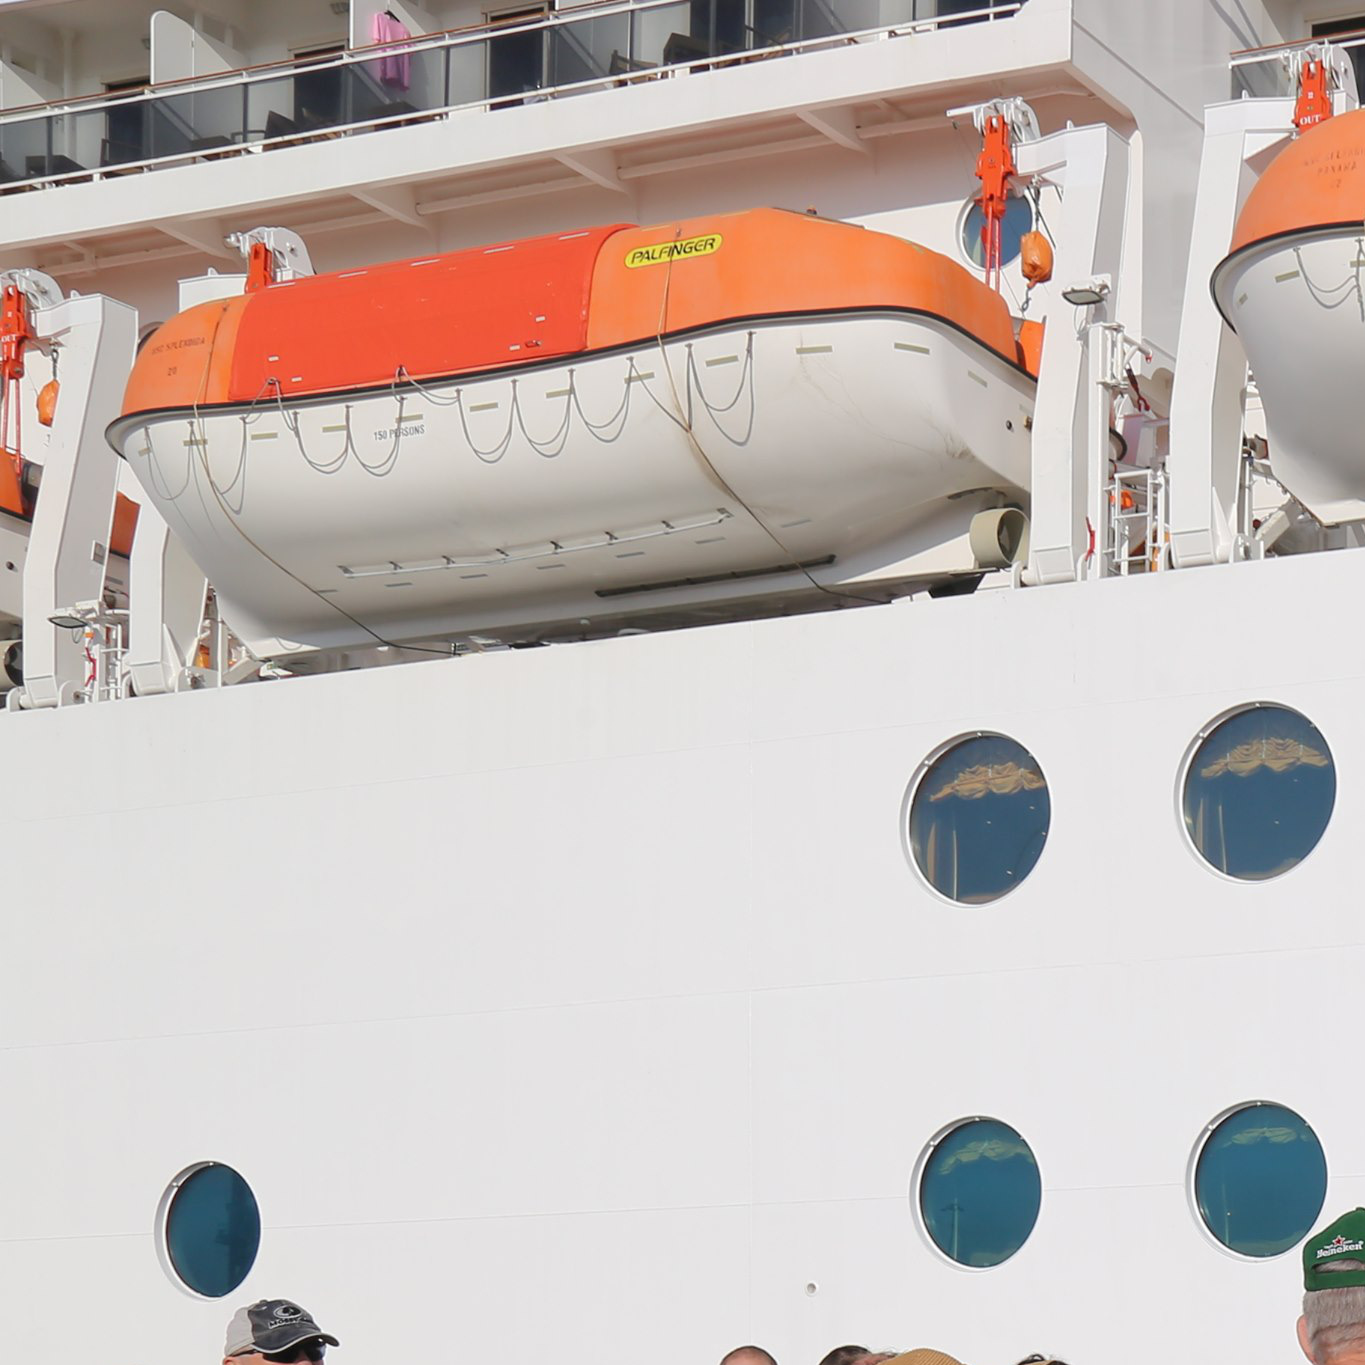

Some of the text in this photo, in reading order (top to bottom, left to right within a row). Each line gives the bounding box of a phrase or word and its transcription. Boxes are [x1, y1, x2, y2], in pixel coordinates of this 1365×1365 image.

[1300, 114, 1321, 125] OUT
[631, 238, 716, 264] PALFINGER
[374, 430, 388, 441] 150
